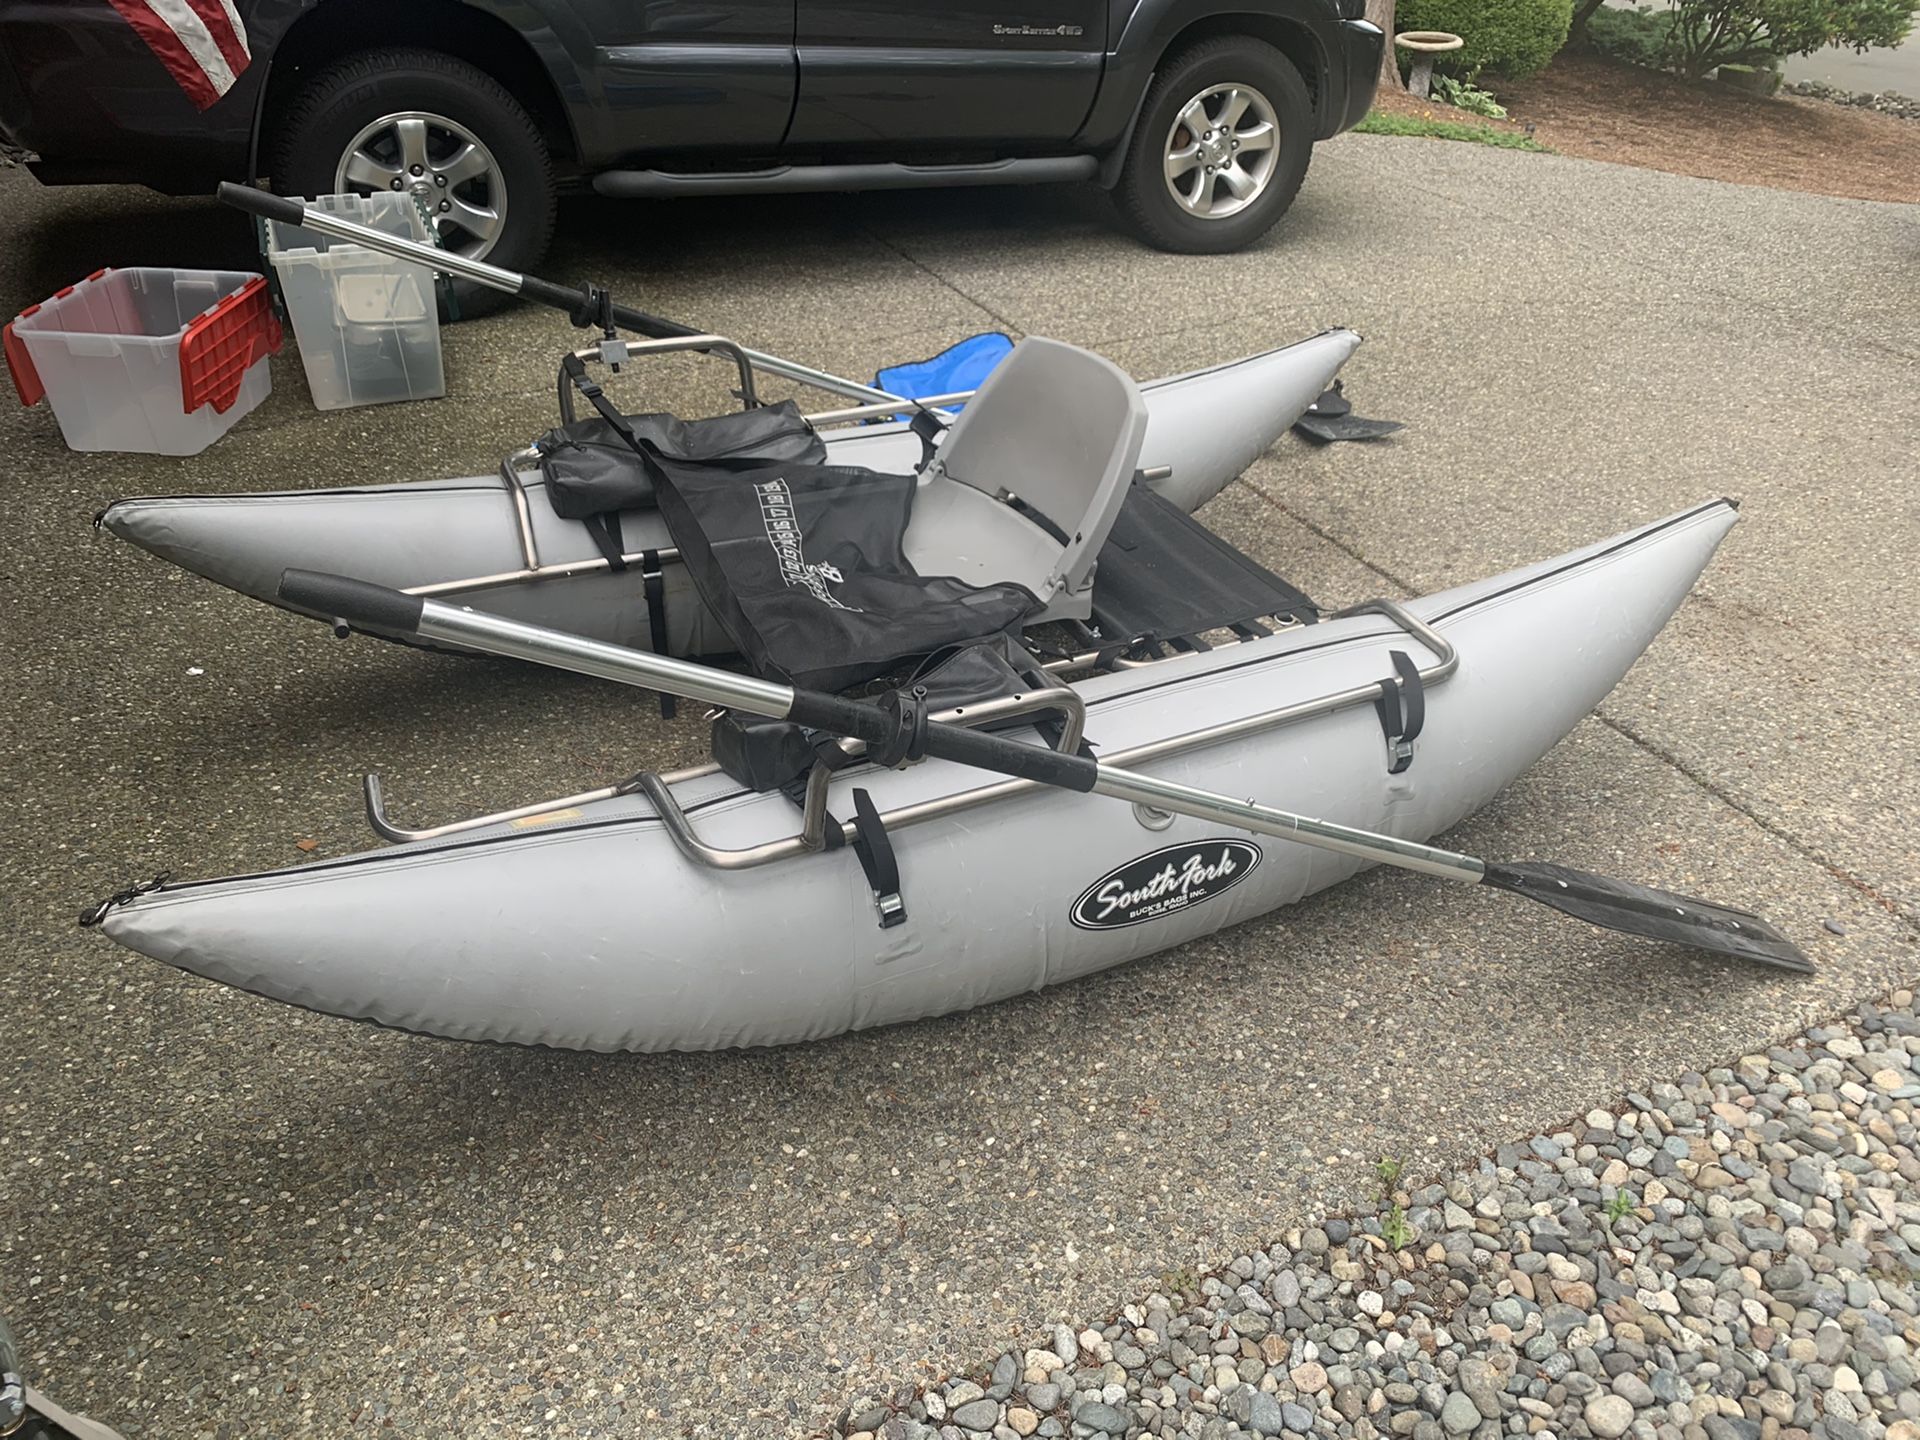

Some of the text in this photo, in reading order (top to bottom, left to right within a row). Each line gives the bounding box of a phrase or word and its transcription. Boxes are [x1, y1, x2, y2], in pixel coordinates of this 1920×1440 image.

[767, 495, 784, 504] 18
[770, 508, 788, 517] 17
[1096, 848, 1236, 919] South Fork
[1129, 888, 1207, 918] BUCK'S BAGS INC.
